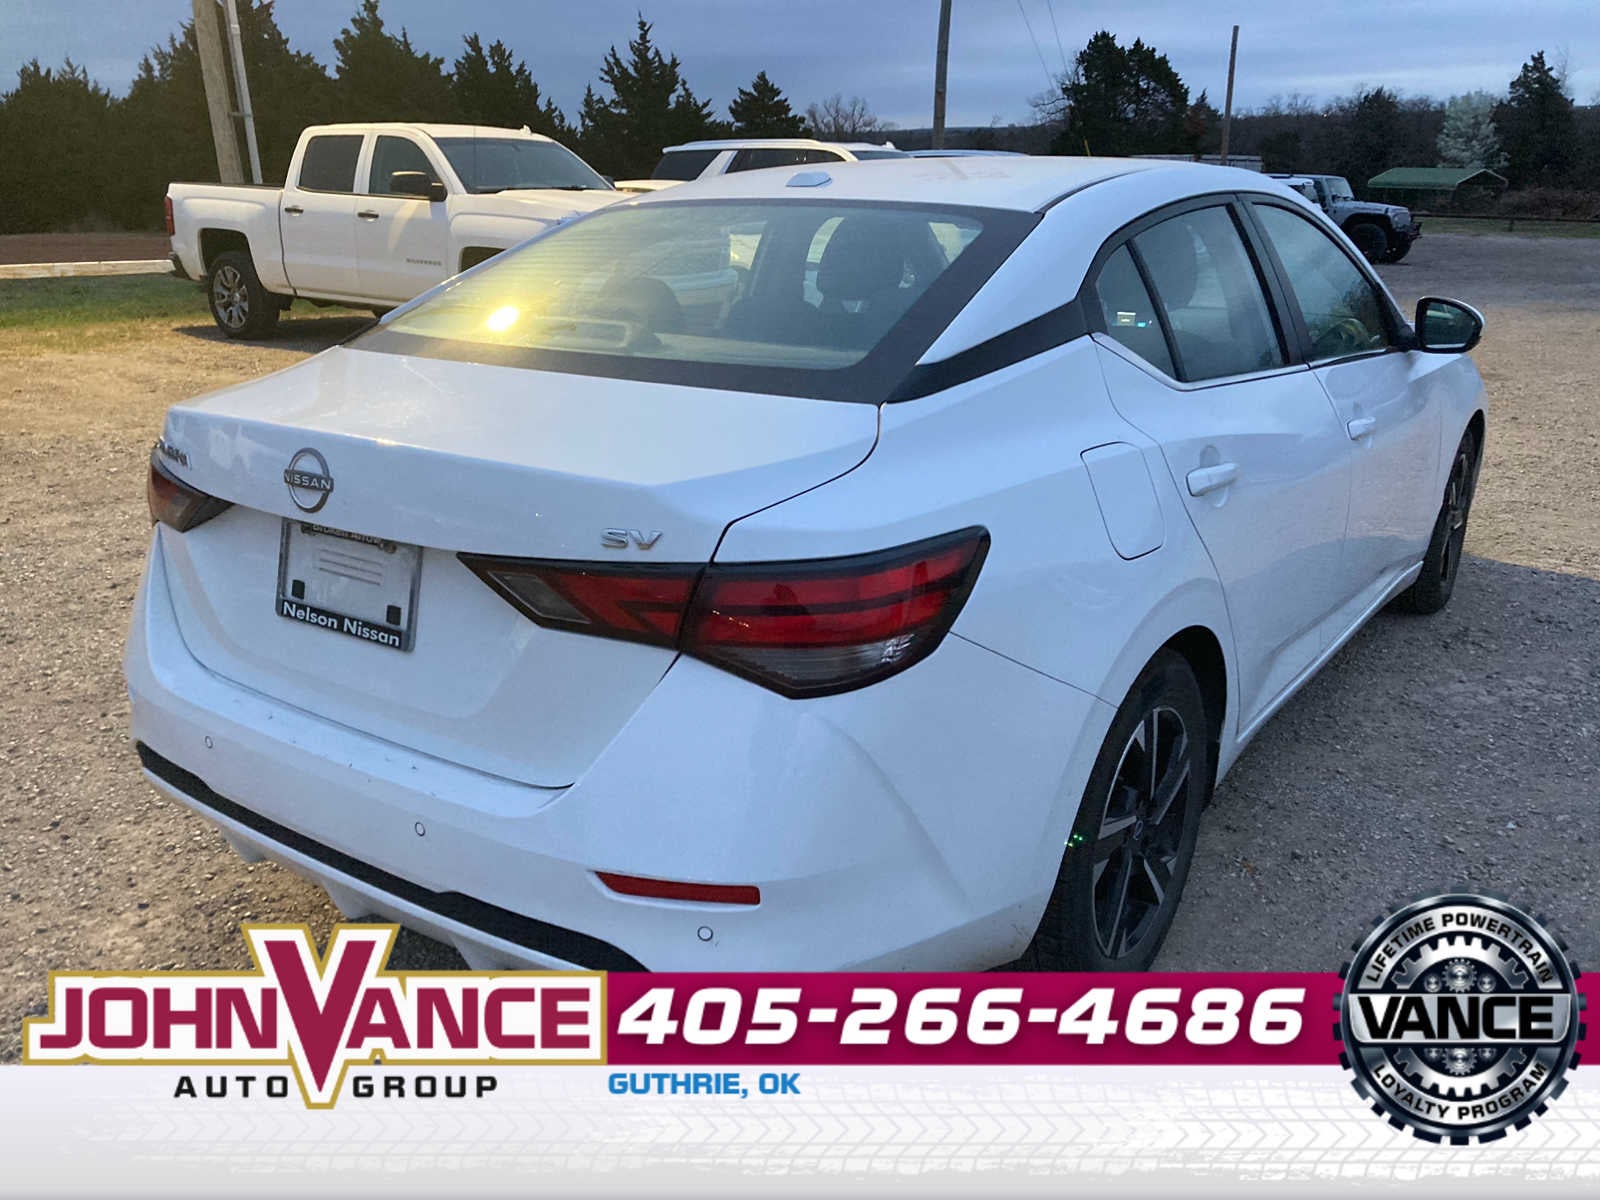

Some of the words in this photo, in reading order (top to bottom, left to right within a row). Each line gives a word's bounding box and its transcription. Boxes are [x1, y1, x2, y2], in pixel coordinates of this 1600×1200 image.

[284, 471, 331, 490] NISSAN
[601, 527, 663, 550] SV
[283, 601, 338, 629] Nelson
[343, 618, 400, 647] Nissan
